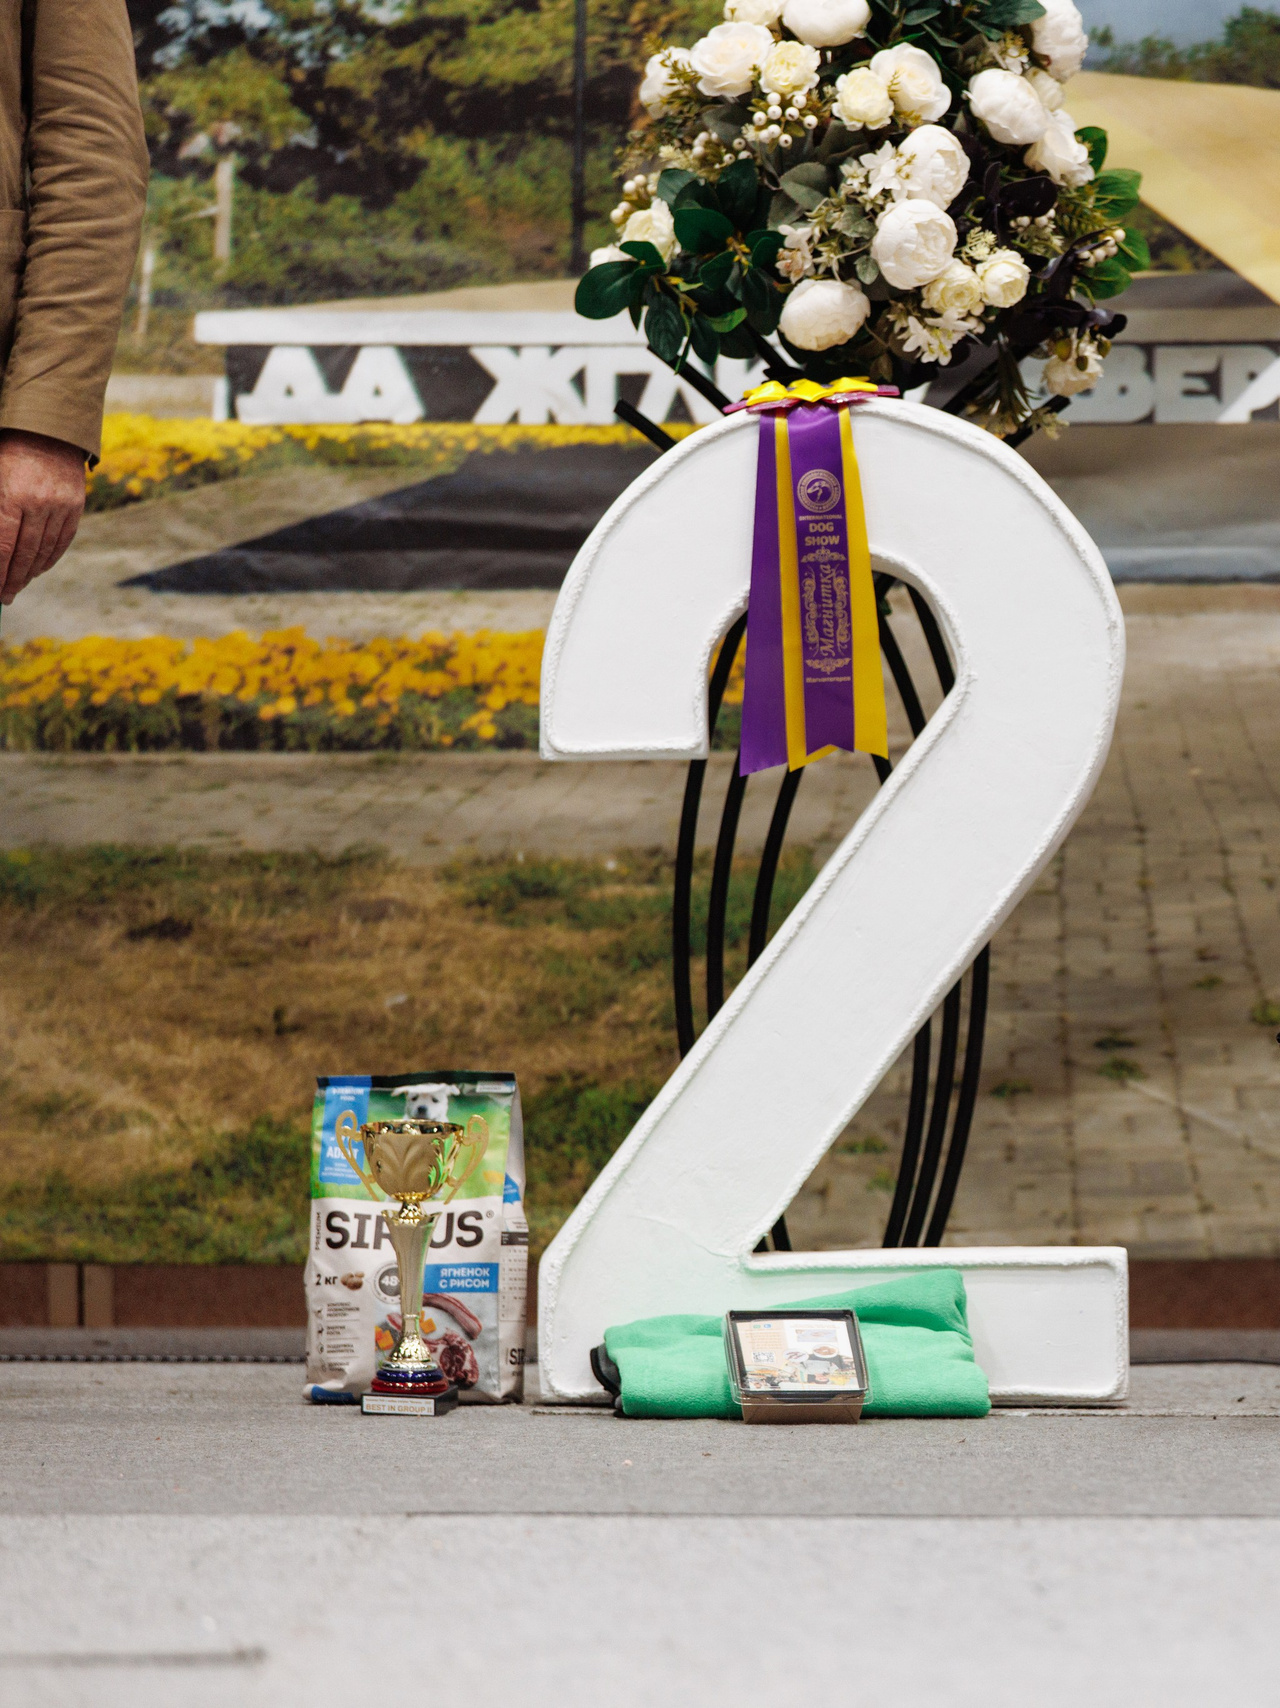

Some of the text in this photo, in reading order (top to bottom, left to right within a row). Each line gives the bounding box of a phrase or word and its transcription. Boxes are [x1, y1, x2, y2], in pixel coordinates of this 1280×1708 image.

[236, 345, 427, 424] ДА
[809, 522, 834, 533] DOG
[804, 535, 840, 546] SHOW
[819, 563, 836, 657] Магнитка
[539, 397, 1129, 1402] 2
[325, 1210, 484, 1250] SIRUS
[440, 1267, 490, 1277] ЯГНЕНОК
[316, 1273, 322, 1286] 2
[439, 1278, 489, 1288] С РИСОМ
[397, 1405, 426, 1413] GROUP
